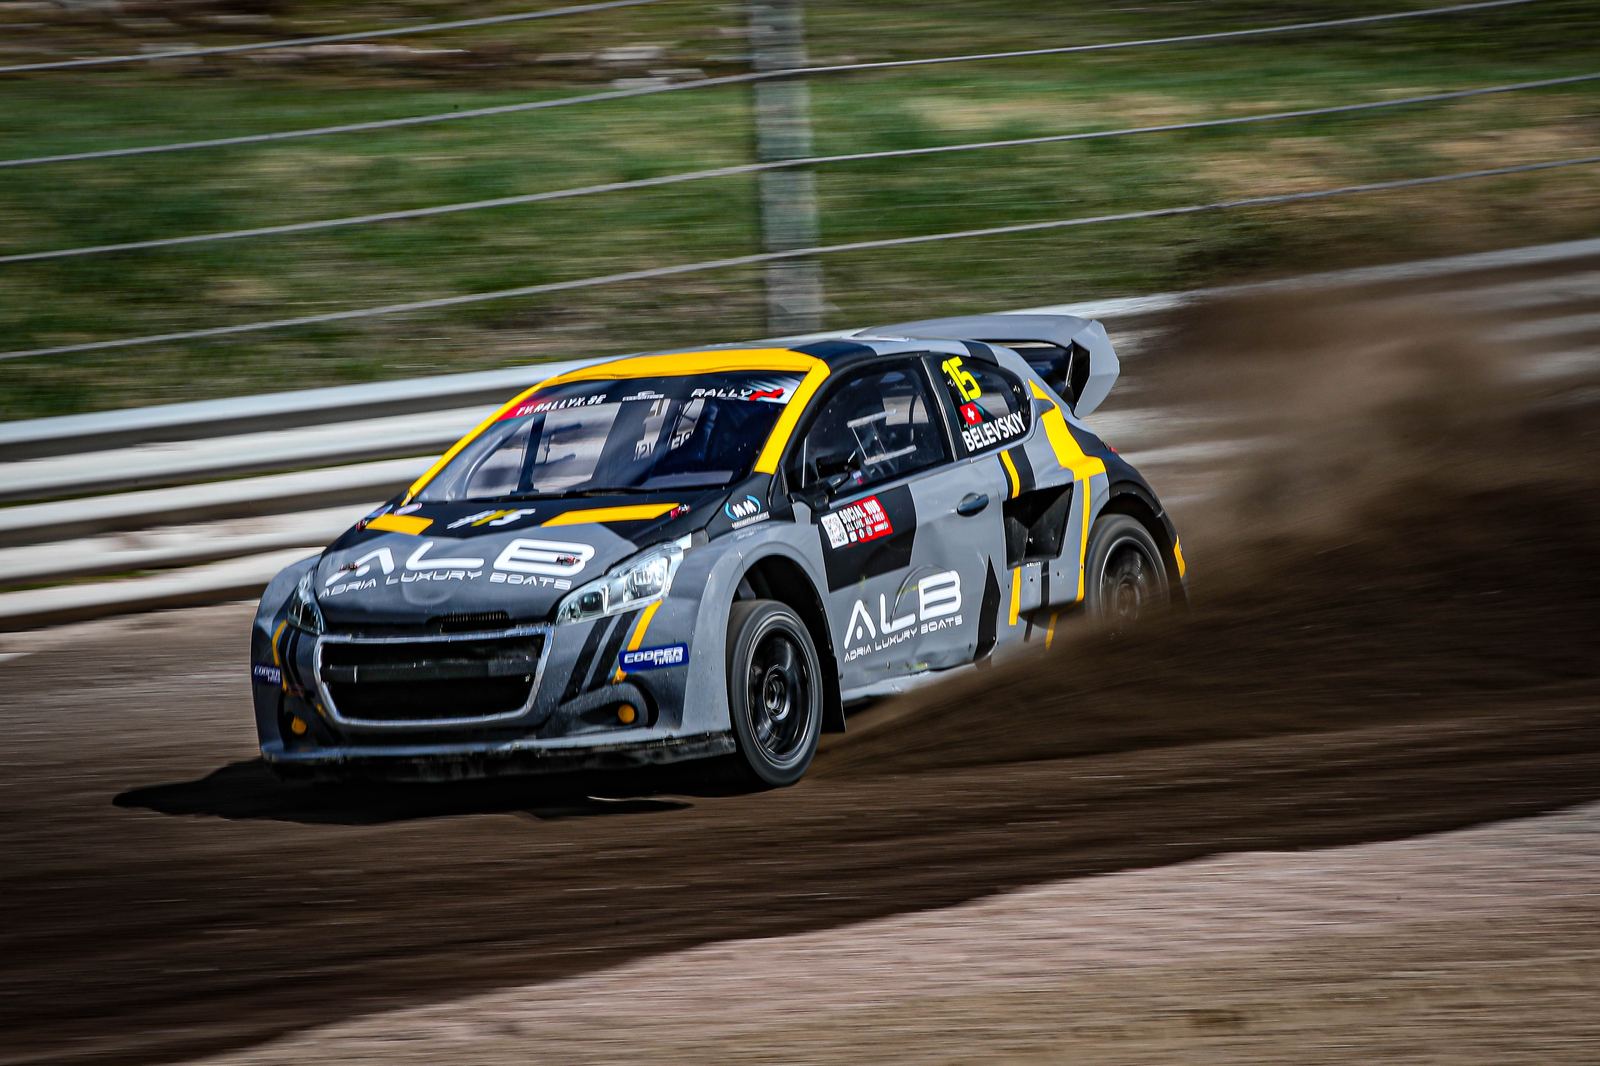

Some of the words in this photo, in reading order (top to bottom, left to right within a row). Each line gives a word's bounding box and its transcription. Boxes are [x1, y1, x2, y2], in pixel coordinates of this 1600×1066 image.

[942, 356, 982, 402] 15
[961, 411, 1026, 452] BELEVSKIY
[838, 505, 867, 524] SOCIAL
[318, 578, 377, 599] ADRIA
[385, 570, 483, 586] LUXURY
[489, 572, 573, 590] BOATS
[325, 539, 596, 587] ALB
[843, 569, 962, 650] ALB
[624, 646, 684, 664] COOPER
[844, 644, 872, 663] ADRIA
[875, 627, 918, 651] LUXURY
[920, 615, 963, 635] BOATS
